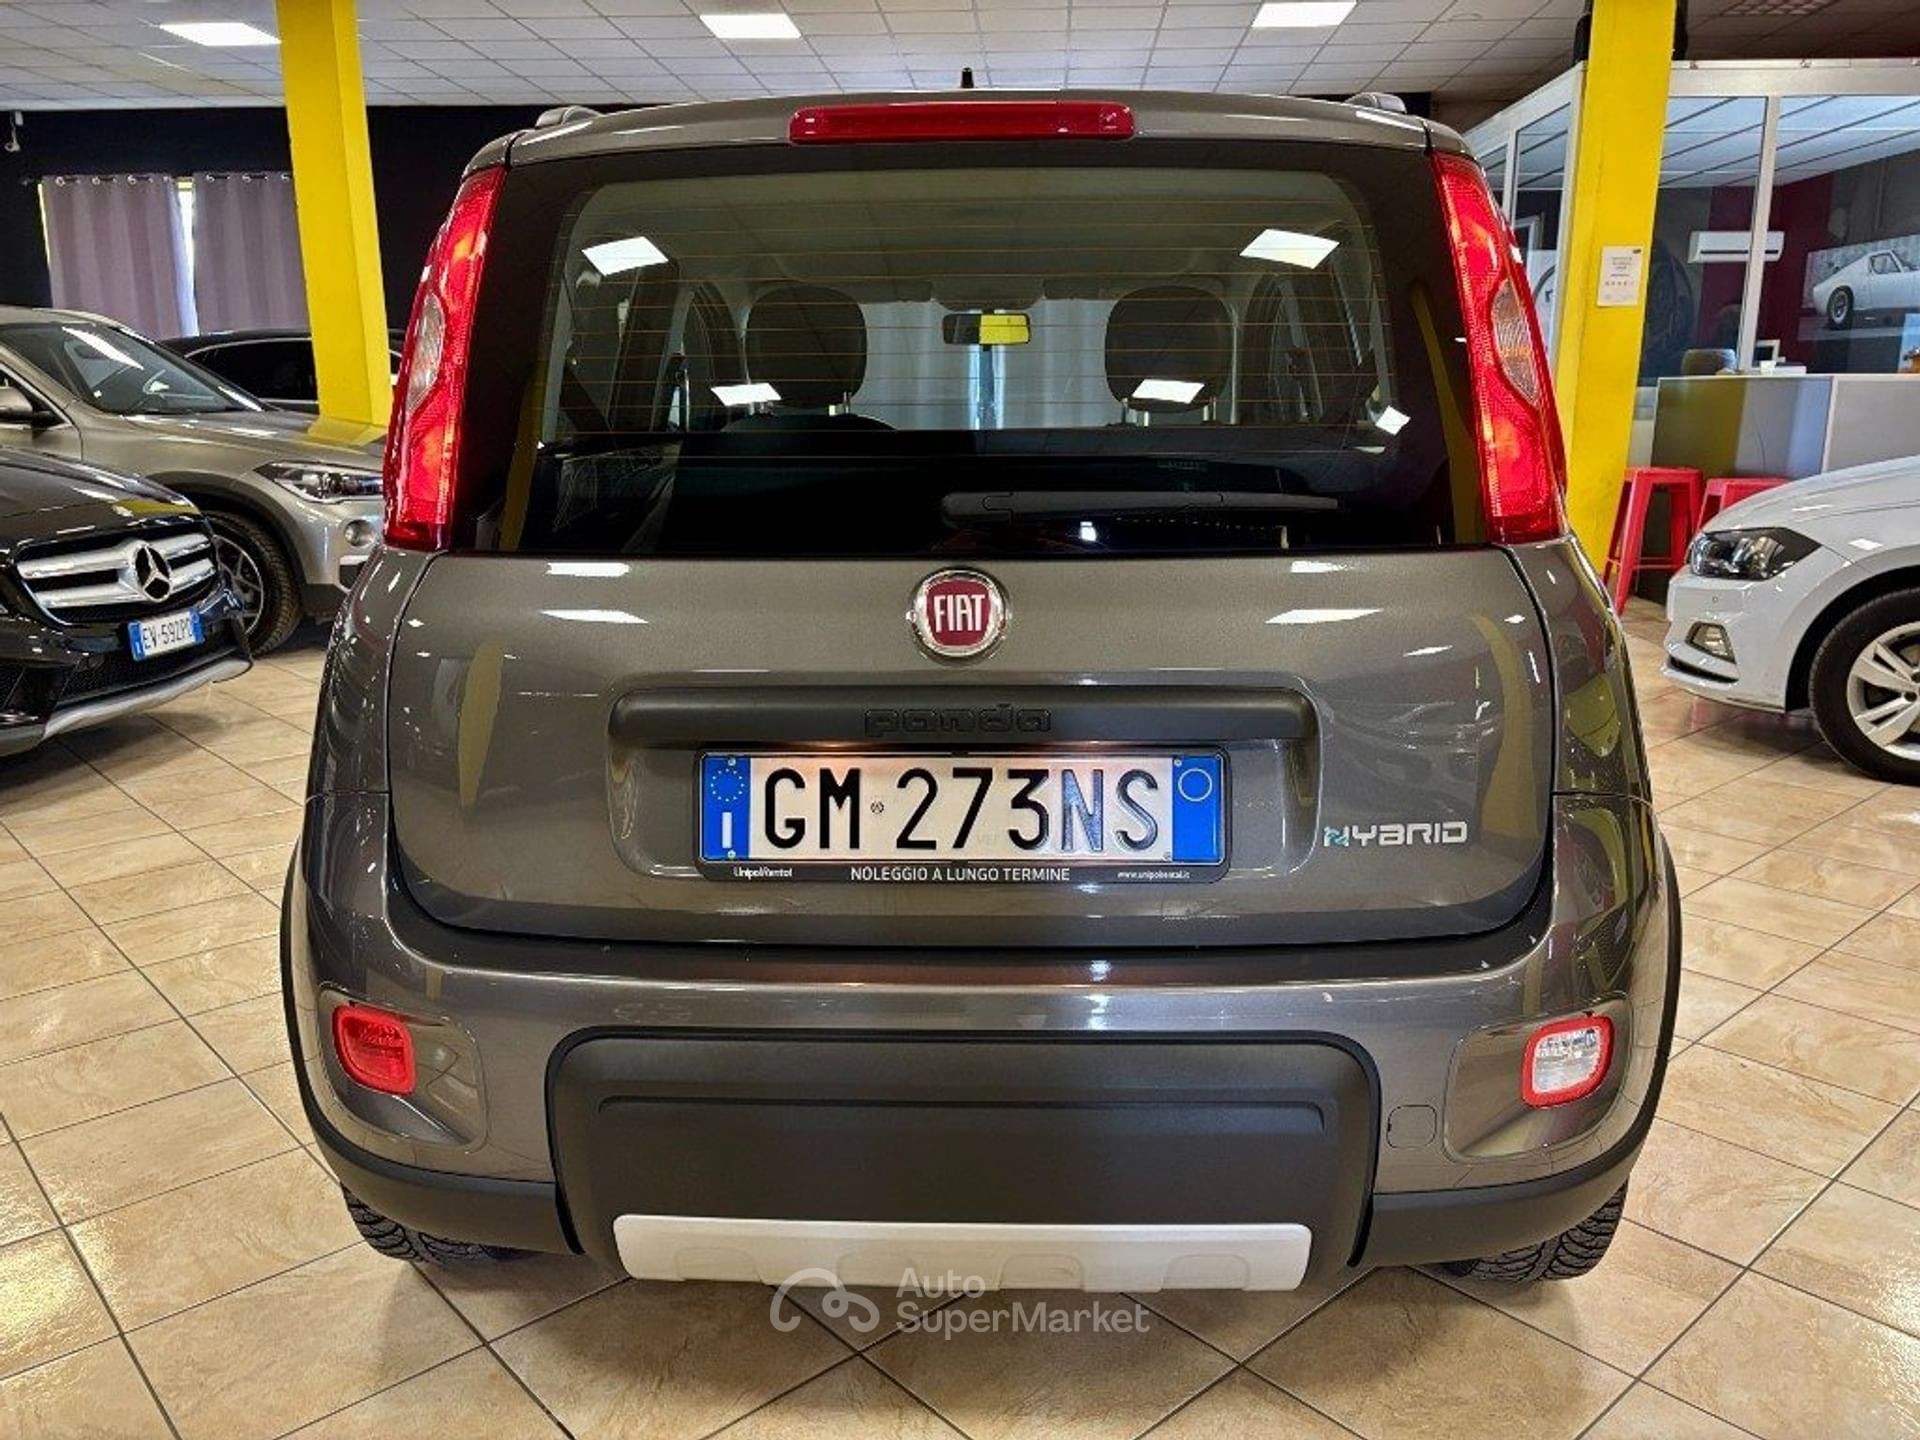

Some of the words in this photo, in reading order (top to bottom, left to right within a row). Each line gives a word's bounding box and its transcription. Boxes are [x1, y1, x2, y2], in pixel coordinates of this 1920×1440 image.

[933, 593, 986, 632] FIAT
[864, 703, 1052, 738] panda
[764, 767, 861, 850] GM
[721, 811, 733, 849] I
[1323, 821, 1468, 848] HYBRID
[850, 866, 929, 881] NOLEGGIO
[931, 867, 943, 881] A
[946, 867, 999, 881] LUNGO
[1002, 867, 1071, 881] TERMINE
